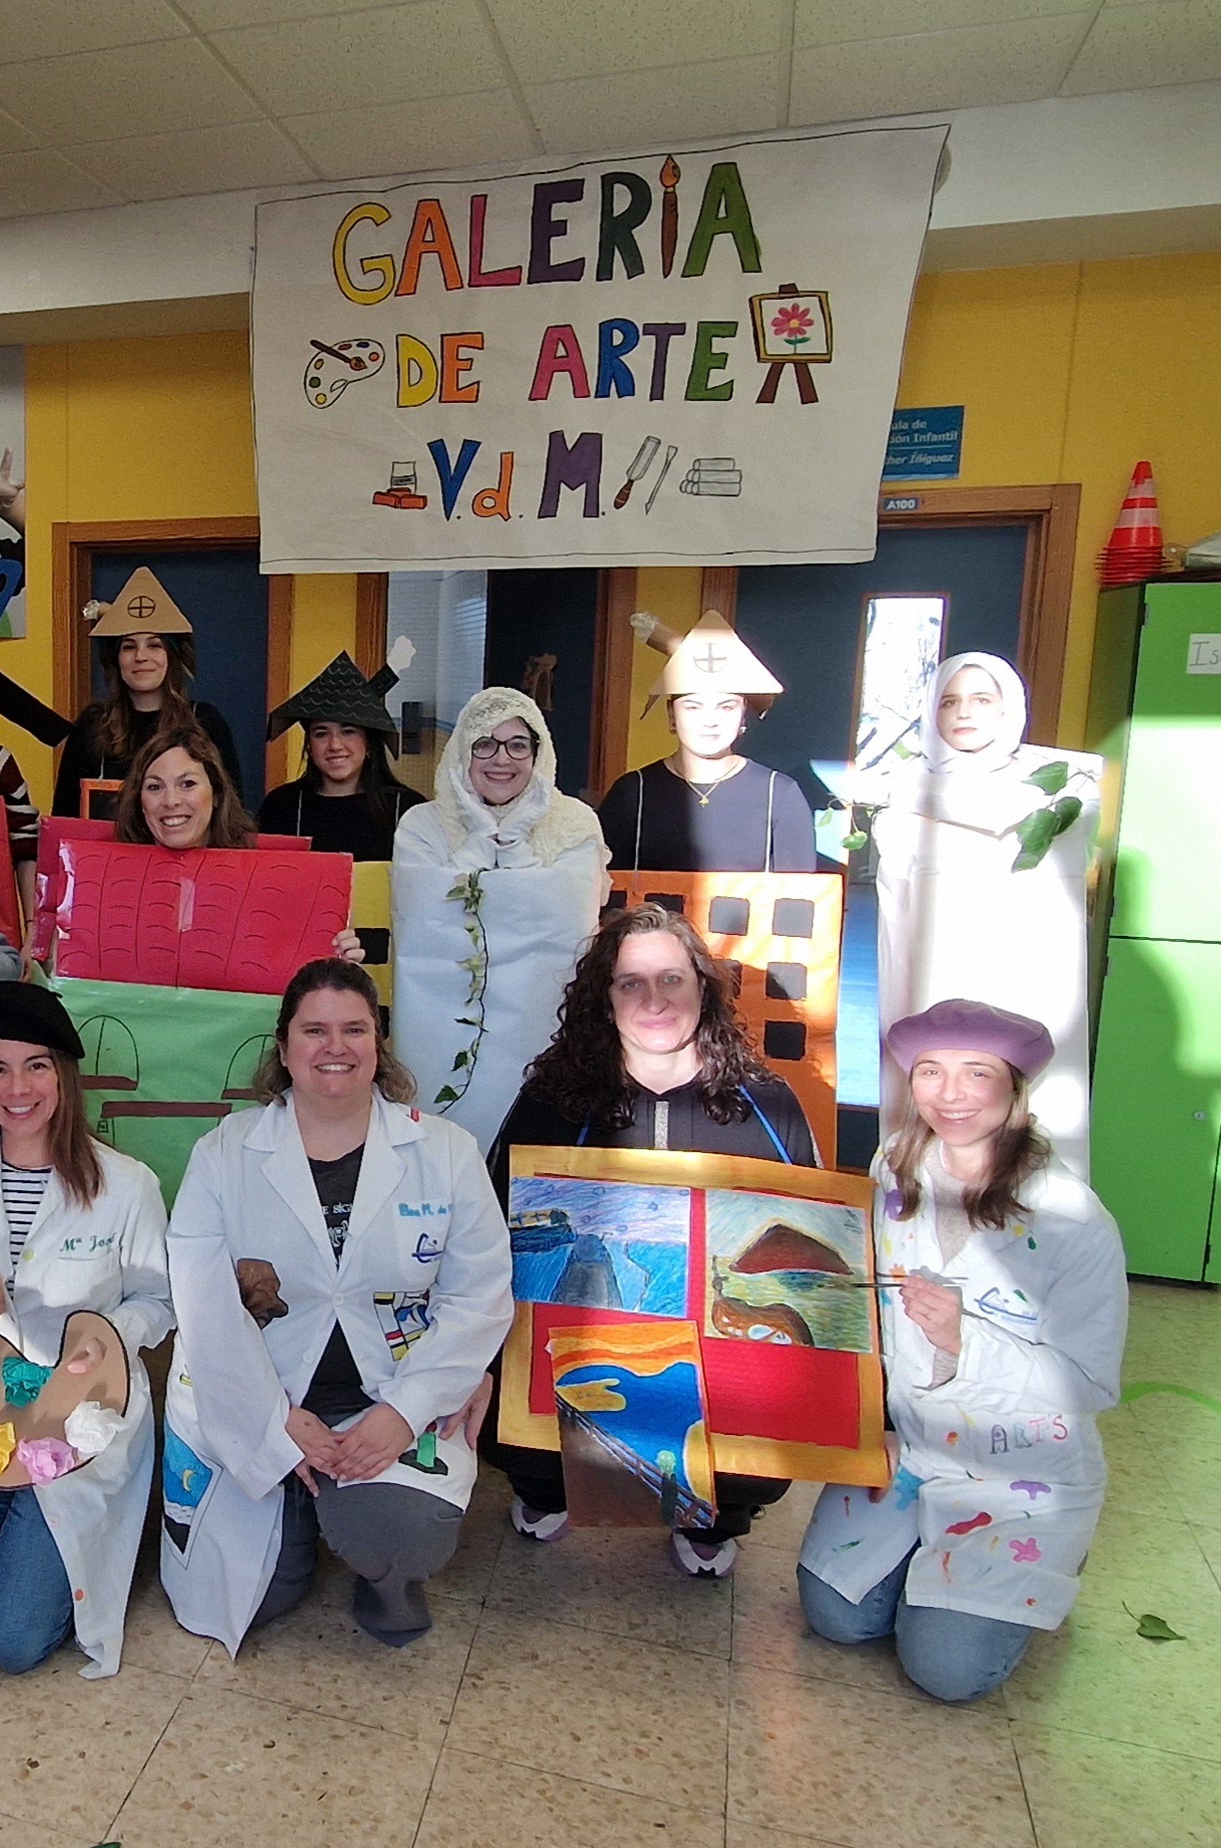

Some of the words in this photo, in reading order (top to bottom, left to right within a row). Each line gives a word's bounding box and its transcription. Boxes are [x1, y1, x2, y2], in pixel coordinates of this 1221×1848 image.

[395, 331, 484, 408] DE
[527, 318, 739, 402] ARTE
[891, 420, 909, 430] ula
[911, 419, 927, 430] de
[913, 430, 958, 444] Infantil
[885, 454, 907, 466] her
[886, 499, 916, 510] A100
[1188, 641, 1221, 667] Is
[990, 1413, 1069, 1455] ARTS
